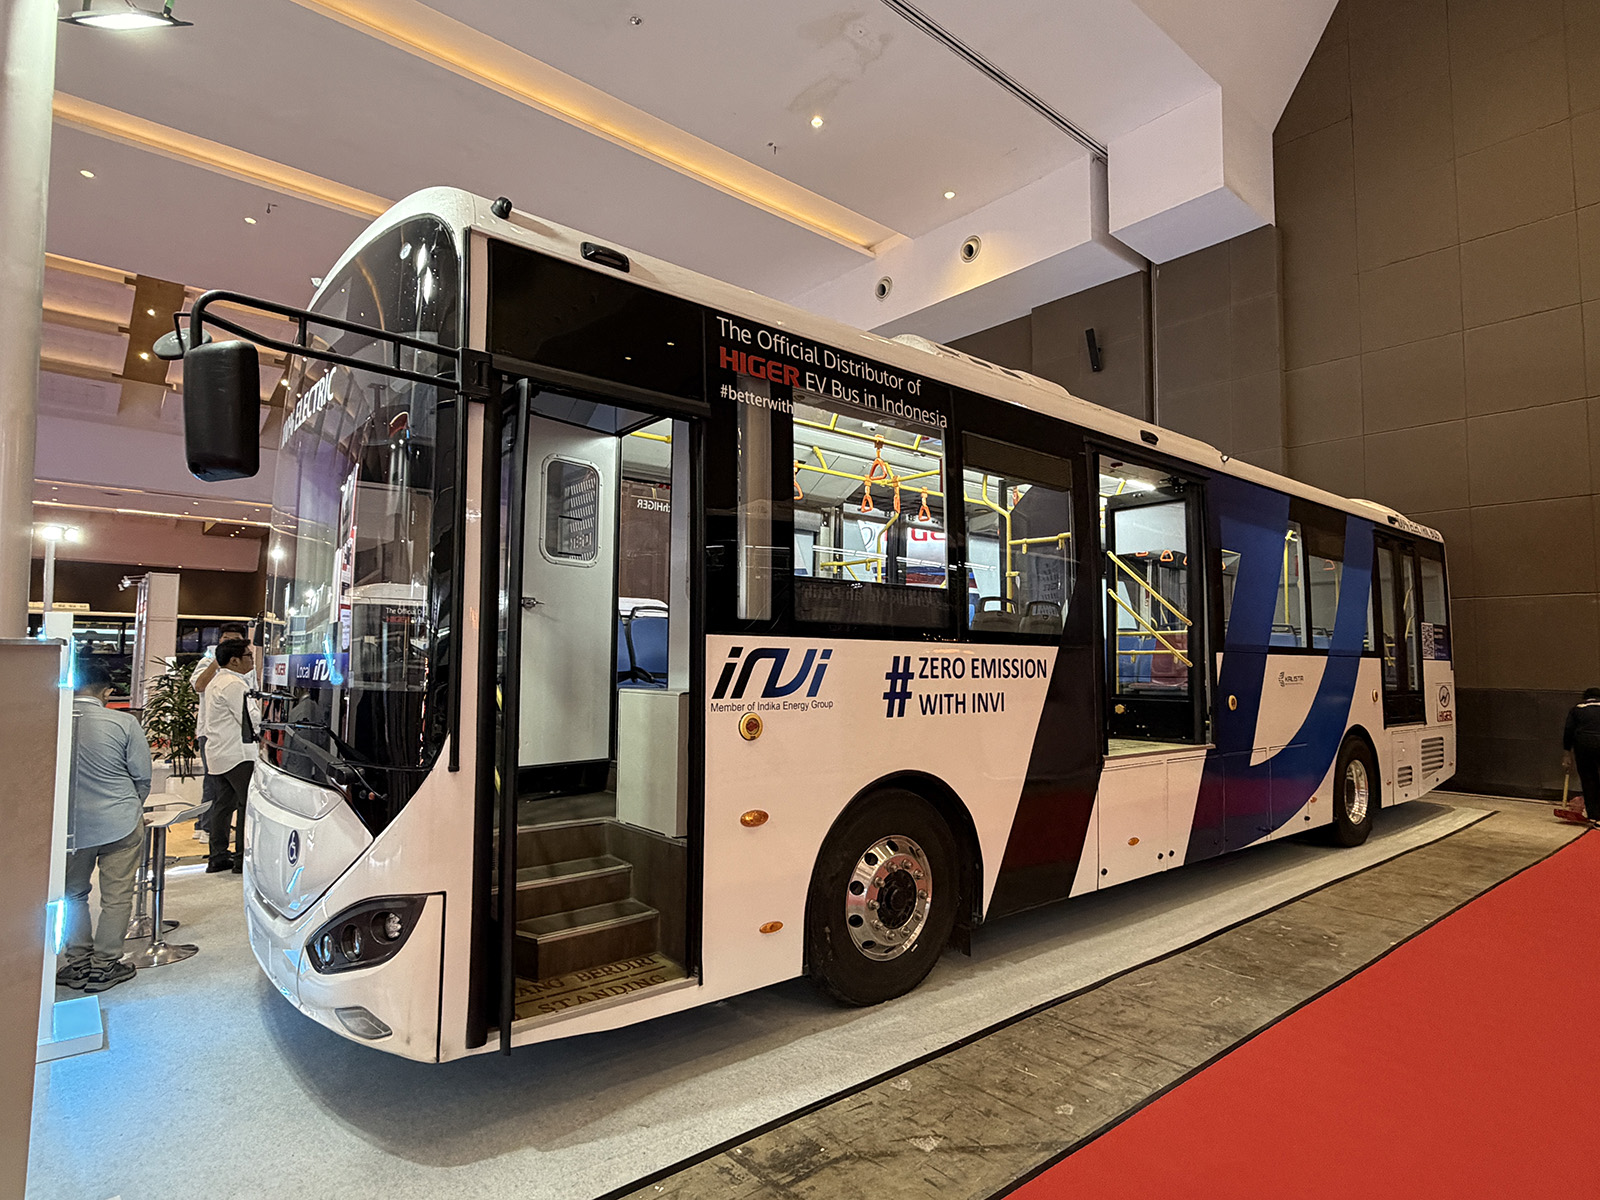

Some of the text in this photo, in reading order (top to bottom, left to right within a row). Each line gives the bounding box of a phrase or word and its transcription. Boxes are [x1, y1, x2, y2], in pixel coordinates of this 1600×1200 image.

[716, 316, 921, 396] The Official Distributor of
[294, 366, 337, 432] ELECTRIC
[719, 346, 948, 429] HIGER EV Bus in Indonesia
[720, 384, 794, 415] #betterwith
[296, 664, 310, 678] Local
[918, 657, 1048, 680] ZERO EMISSION
[710, 700, 834, 712] Member of Indika Energy Group
[919, 692, 1005, 716] WITH INVI
[514, 954, 660, 999] ANG BERDIRI
[538, 974, 668, 1014] STANDING
